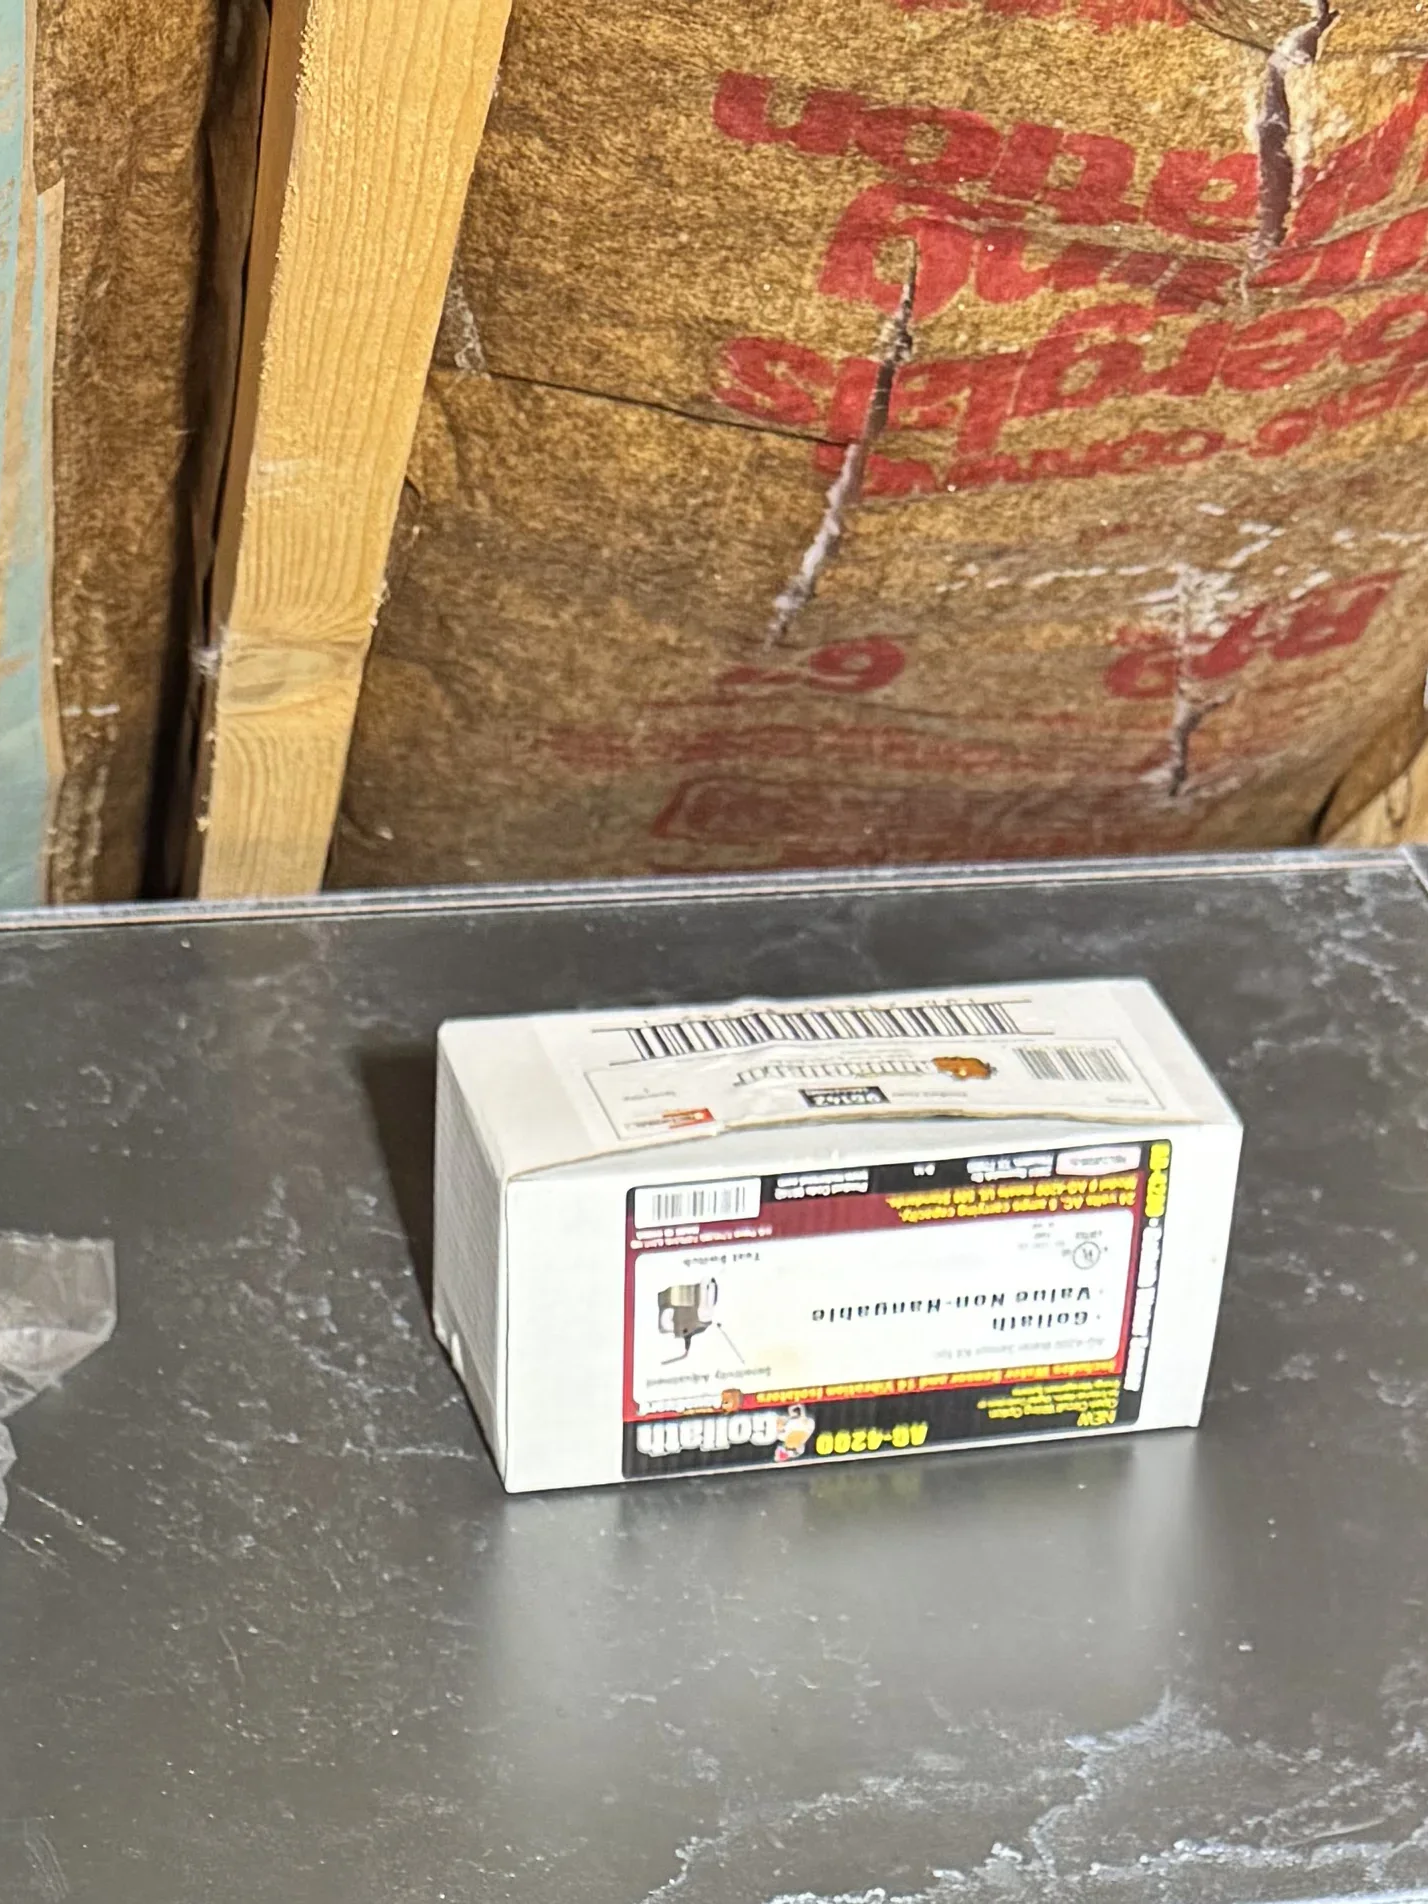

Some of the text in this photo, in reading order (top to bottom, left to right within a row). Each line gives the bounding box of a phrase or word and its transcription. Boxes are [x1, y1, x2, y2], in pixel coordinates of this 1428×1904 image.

[811, 1286, 1091, 1323] Value Non-Hangable
[992, 1311, 1088, 1331] Goliath
[636, 1411, 778, 1457] Goliath
[1076, 1409, 1117, 1426] NEW
[815, 1421, 929, 1455] AG-4200
